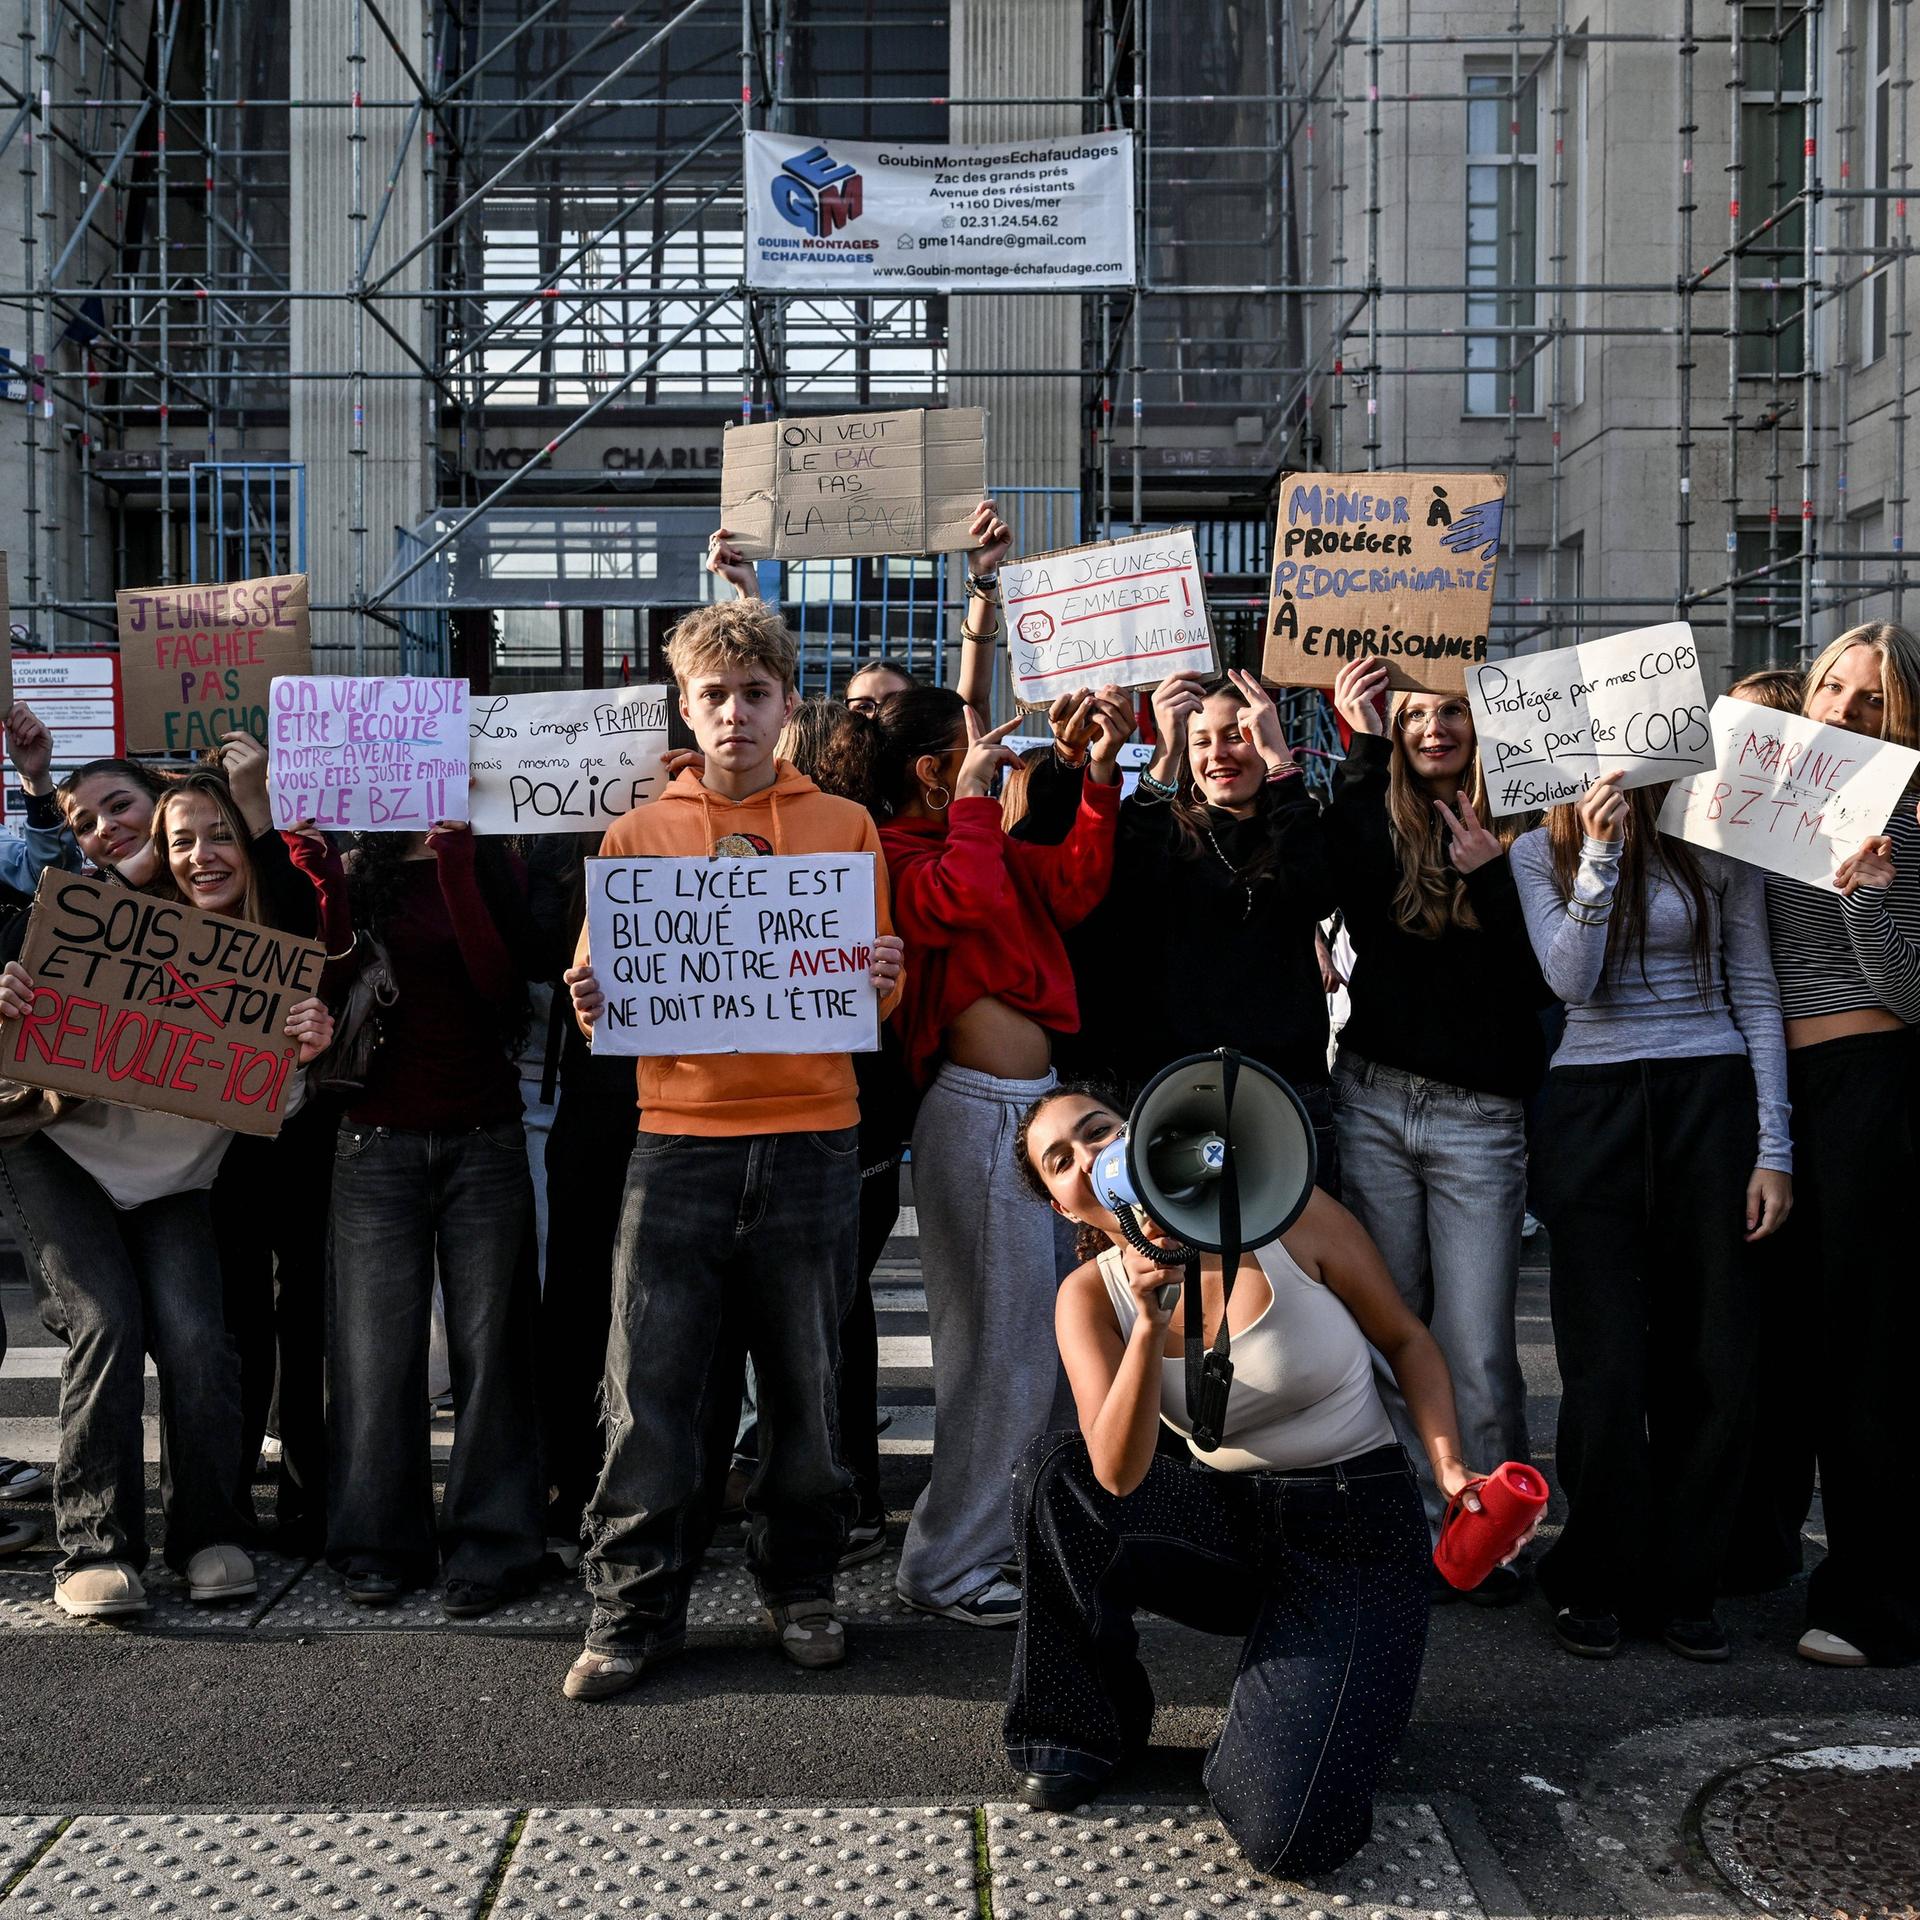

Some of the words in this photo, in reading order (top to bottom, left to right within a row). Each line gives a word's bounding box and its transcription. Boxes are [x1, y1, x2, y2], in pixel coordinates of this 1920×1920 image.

[878, 145, 1118, 169] GoubinMontagesEchafaudages
[930, 187, 978, 198] Avenue
[982, 186, 1006, 197] des
[1010, 181, 1075, 194] résistants
[935, 173, 959, 184] Zac
[963, 172, 986, 183] des
[990, 170, 1035, 184] grands
[1040, 166, 1068, 181] prés
[994, 197, 1061, 209] Dives/mer
[960, 215, 1058, 228] 02.31.24.54.62
[758, 238, 800, 248] GOUBIN
[802, 239, 879, 249] MONTAGES
[762, 251, 874, 263] ECHAFAUDAGES
[919, 234, 1086, 249] gme14andre@gmail.com
[873, 262, 1122, 277] www.Goubin-montage-échafaudage.com
[784, 426, 822, 446] ON
[837, 420, 897, 440] VEUT
[603, 447, 722, 470] CHARLE
[789, 453, 821, 472] LE
[835, 445, 886, 470] BAC
[818, 474, 863, 494] PAS
[785, 506, 825, 536] LA
[1427, 486, 1452, 527] À
[1008, 569, 1053, 598] LA
[1074, 549, 1192, 583] JEUNESSE
[129, 584, 296, 632] JEUNESSE
[1062, 584, 1170, 621] EMMERDE
[1273, 589, 1299, 640] À
[1021, 618, 1048, 633] STOP
[156, 627, 264, 670] FACHÉE
[1019, 636, 1123, 675] L'ÉDUC
[181, 669, 240, 704] PAS
[331, 680, 384, 712] VEUT
[393, 680, 463, 715] JUSTE
[1478, 665, 1562, 722] Protégée
[1570, 679, 1599, 707] par
[1605, 670, 1636, 687] mes
[1640, 646, 1696, 680] COPS
[278, 711, 330, 742] ETRE
[470, 696, 517, 739] Les
[529, 721, 589, 744] images
[343, 743, 414, 764] AVENIR
[1495, 738, 1533, 773] pas
[1544, 729, 1586, 764] par
[1591, 718, 1616, 743] les
[1624, 705, 1709, 754] COPS
[276, 771, 318, 790] VOUS
[324, 766, 360, 787] ETES
[366, 763, 412, 784] JUSTE
[470, 759, 502, 770] mais
[519, 757, 569, 769] moins
[580, 758, 605, 776] que
[619, 752, 635, 767] la
[1739, 730, 1856, 792] MARINE
[369, 786, 419, 824] BZ
[1501, 772, 1600, 808] #Solidarit
[605, 868, 653, 904] CE
[675, 865, 767, 901] LYCÉE
[789, 868, 850, 896] EST
[52, 884, 183, 960] SOIS
[188, 919, 326, 994] JEUNE
[613, 903, 733, 949] BLOQUÉ
[758, 909, 839, 945] PARCE
[39, 945, 111, 988] ET
[613, 953, 667, 984] QUE
[681, 950, 780, 984] NOTRE
[608, 997, 637, 1030] NE
[714, 994, 754, 1019] PAS
[767, 987, 858, 1021] L'ÊTRE
[861, 1160, 890, 1178] NDER
